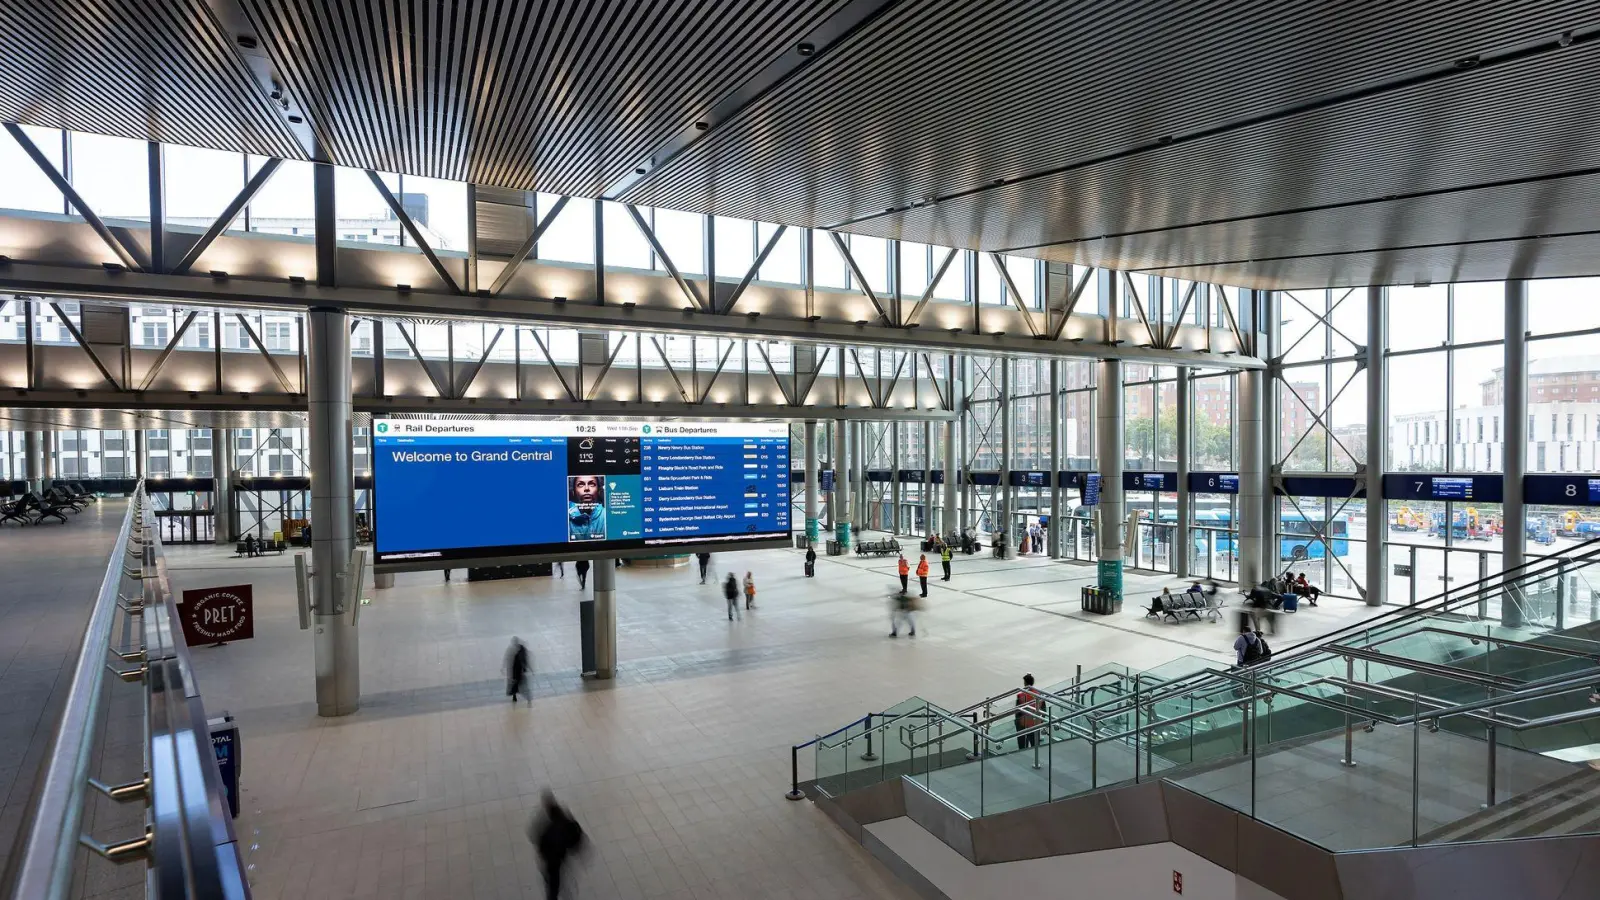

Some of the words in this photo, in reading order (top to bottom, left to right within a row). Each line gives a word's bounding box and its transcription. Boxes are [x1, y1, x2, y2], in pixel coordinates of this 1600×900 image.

[426, 425, 474, 433] Departures
[392, 451, 452, 462] Welcome
[456, 452, 468, 461] to
[472, 450, 508, 461] Grand
[512, 450, 552, 461] Central
[1134, 476, 1140, 484] 5
[1208, 478, 1214, 486] 6
[1414, 482, 1424, 492] 7
[1566, 484, 1576, 496] 8
[194, 592, 220, 610] ORGANIC
[222, 592, 244, 606] COFFEE
[204, 606, 236, 624] PRET
[192, 621, 216, 638] FRESHLY
[217, 628, 235, 638] MADE
[234, 616, 246, 630] FOOD
